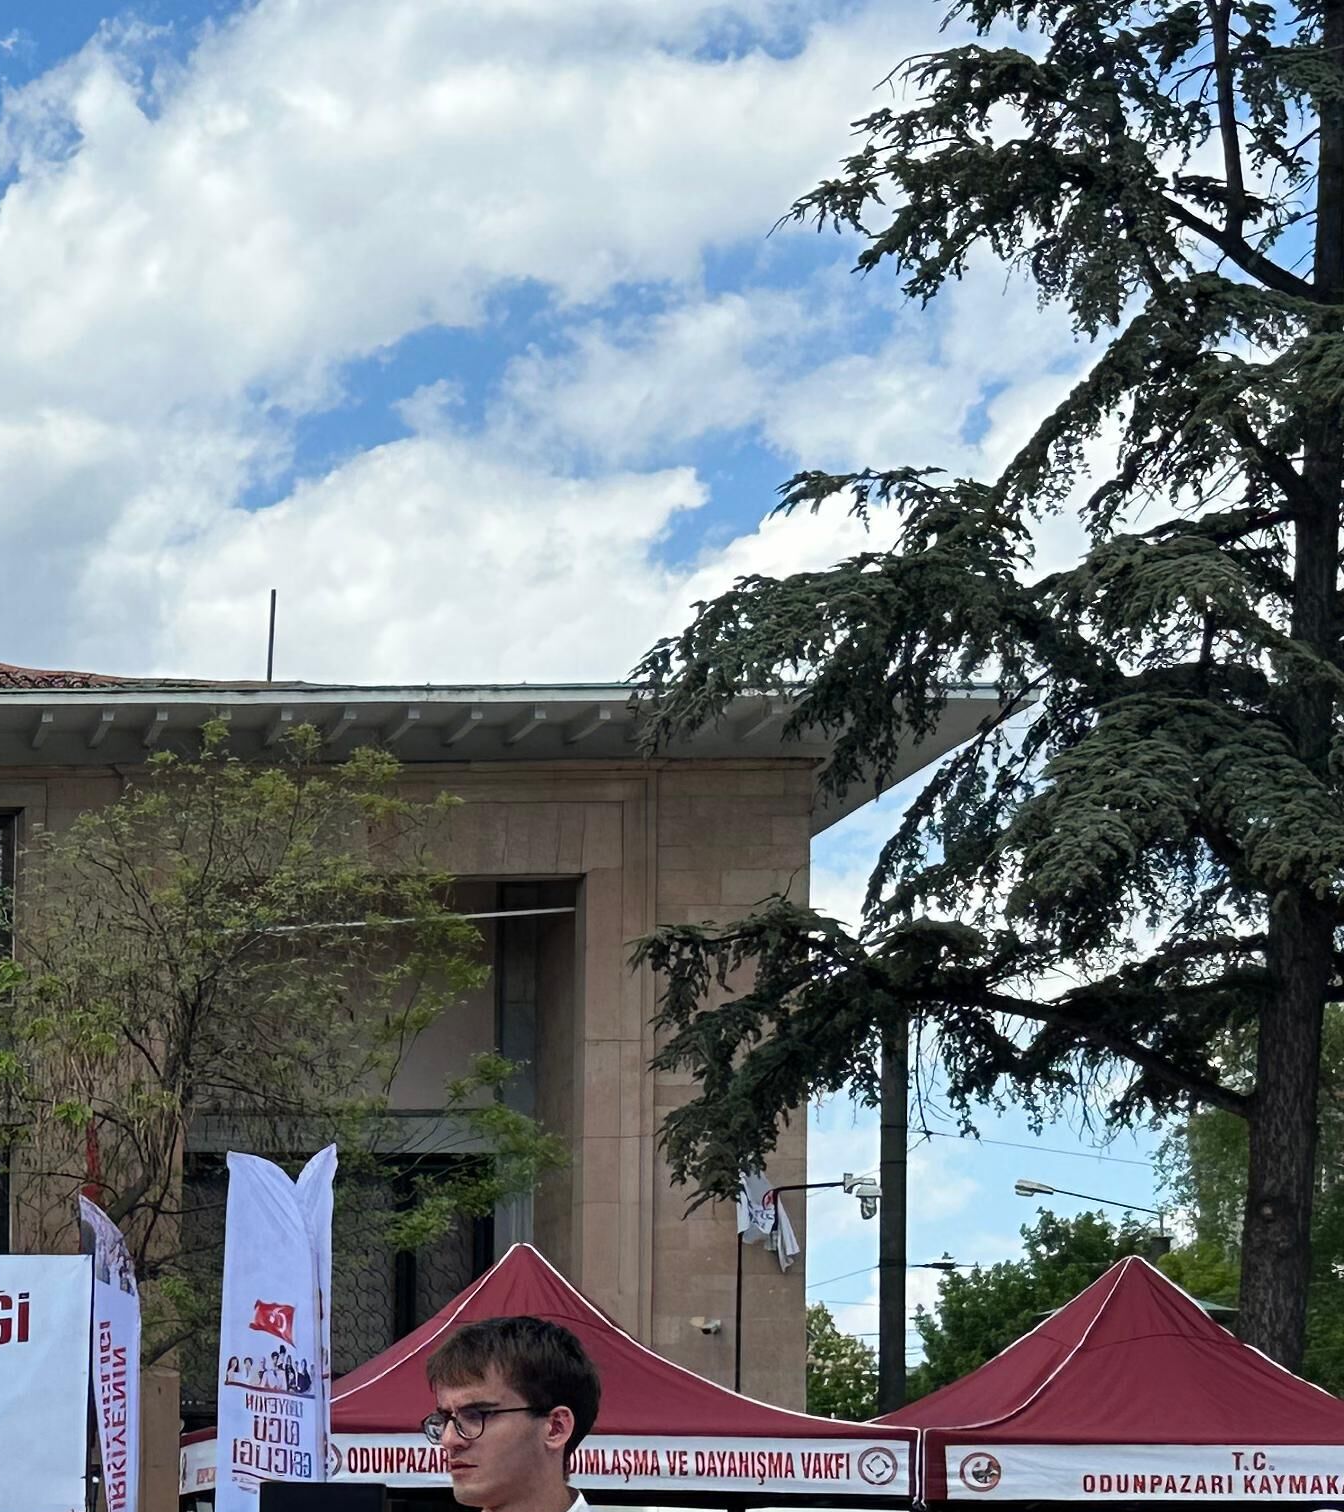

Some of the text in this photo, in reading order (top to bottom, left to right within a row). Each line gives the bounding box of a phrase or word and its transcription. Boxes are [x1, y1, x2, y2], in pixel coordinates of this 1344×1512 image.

[347, 1446, 851, 1485] ODUNPAZAR DIMLAŞMA VE DAYANIŞMA VAKFI
[1231, 1450, 1276, 1472] T.C.
[1082, 1473, 1234, 1494] ODUNPAZARI
